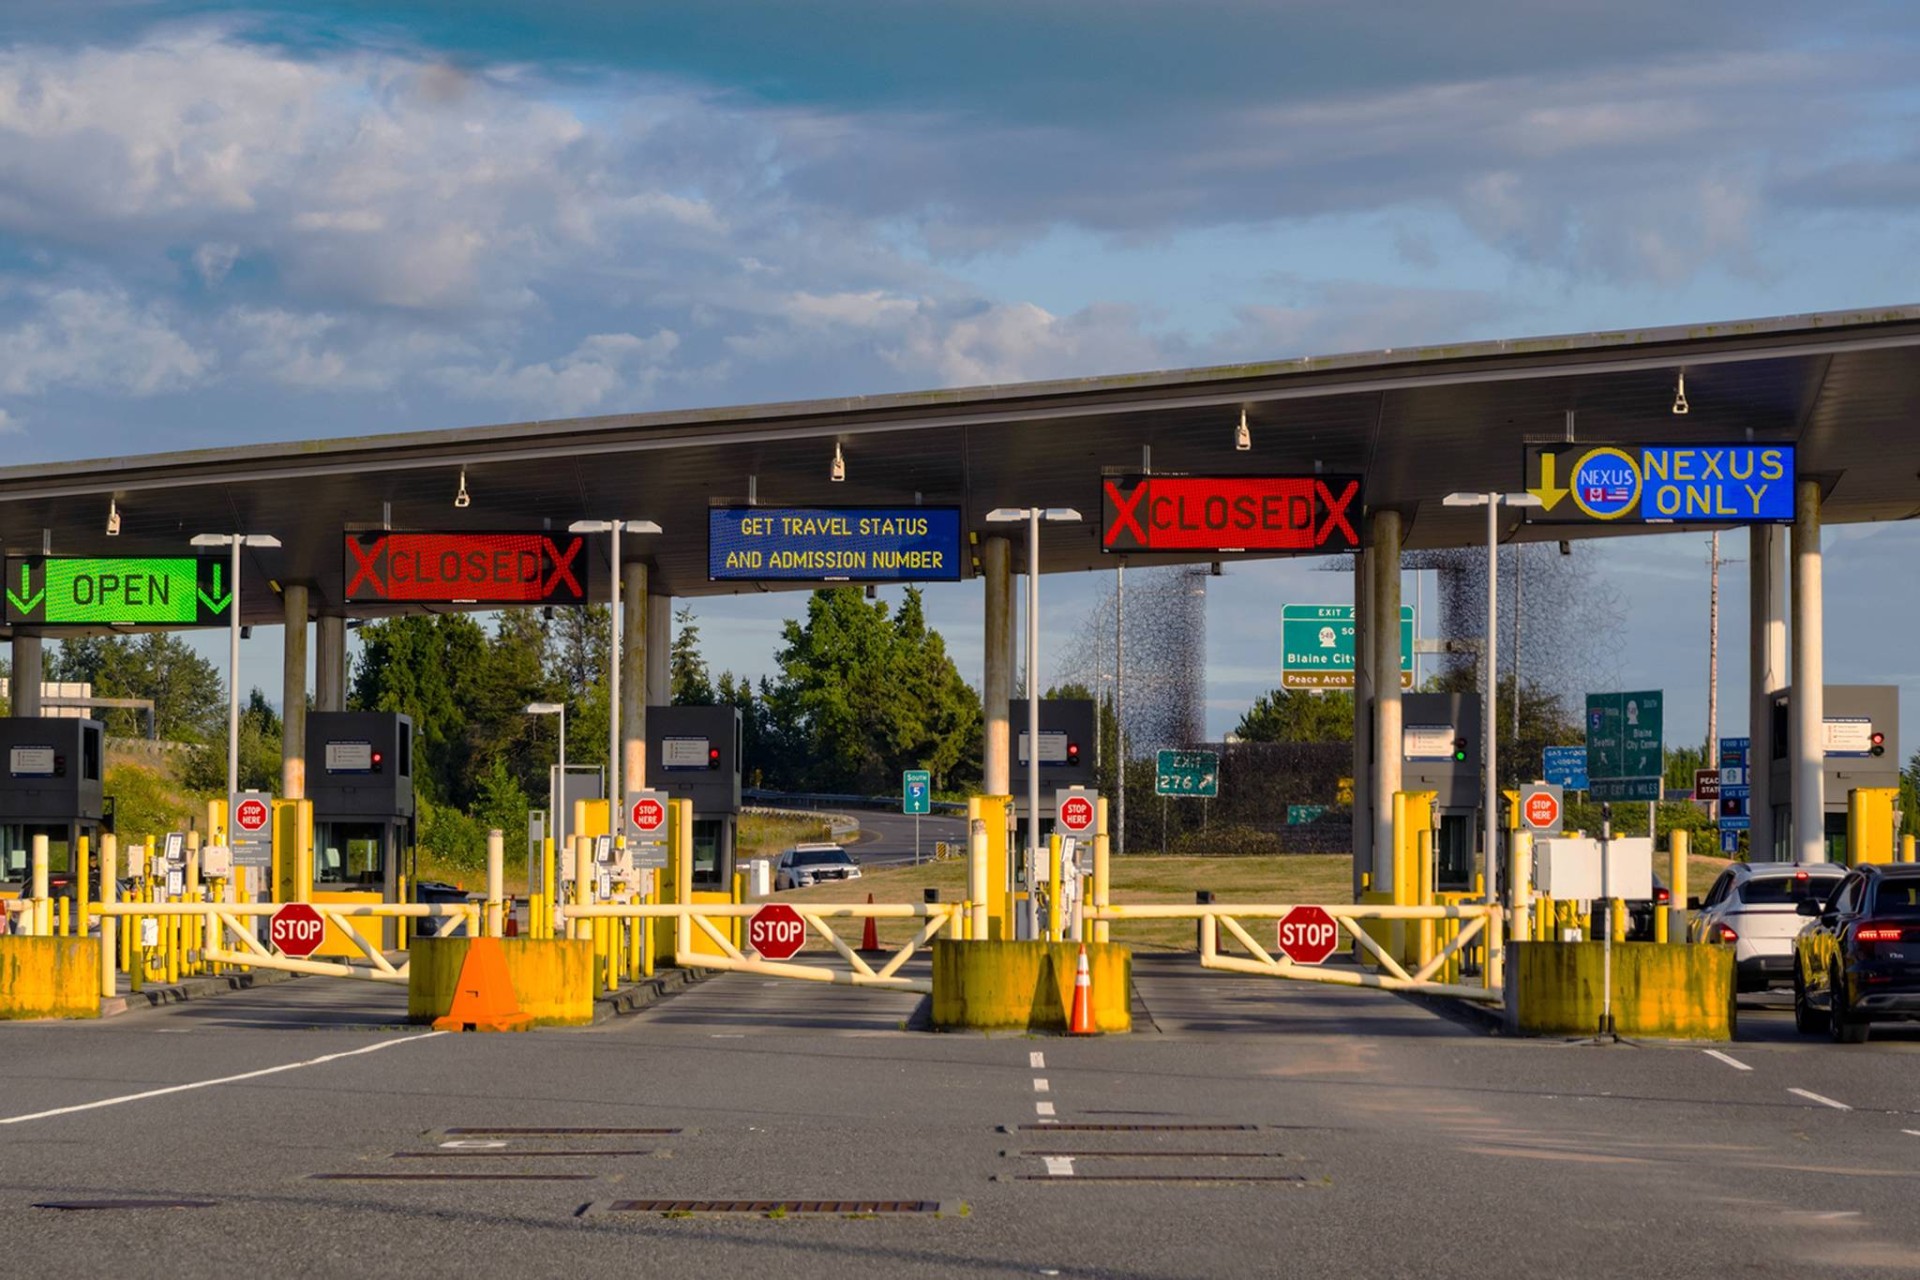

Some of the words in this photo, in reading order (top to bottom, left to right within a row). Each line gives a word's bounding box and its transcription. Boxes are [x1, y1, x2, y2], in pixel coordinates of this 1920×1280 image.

[1644, 450, 1784, 481] NEXUS
[1580, 469, 1634, 486] NEXUS
[1656, 484, 1769, 515] ONLY
[1151, 495, 1312, 531] CLOSED
[741, 518, 774, 536] GET
[782, 518, 852, 536] TRAVEL
[859, 518, 928, 536] STATUS
[725, 551, 762, 569] AND
[769, 551, 866, 569] ADMISSION
[872, 551, 943, 569] NUMBER
[389, 551, 539, 583] CLOSED
[73, 574, 169, 606] OPEN
[1318, 608, 1341, 617] EXIT
[1287, 653, 1328, 664] Blaine
[1288, 675, 1318, 684] Peace
[1323, 675, 1347, 684] Arch
[1593, 714, 1600, 729] 5
[1626, 740, 1638, 751] City
[1641, 740, 1659, 749] Center
[1173, 756, 1201, 769] EXIT
[1160, 775, 1192, 789] 276
[1700, 777, 1719, 785] PEAC
[913, 786, 921, 798] 5
[1637, 783, 1658, 795] MILES
[1701, 786, 1720, 794] STAT
[243, 806, 262, 815] STOP
[639, 806, 658, 815] STOP
[1067, 803, 1087, 814] STOP
[1532, 800, 1552, 810] STOP
[242, 816, 262, 825] HERE
[638, 815, 658, 825] HERE
[1066, 814, 1087, 824] HERE
[1532, 810, 1552, 820] HERE
[273, 919, 322, 940] STOP
[752, 921, 802, 942] STOP
[1282, 923, 1334, 946] STOP
